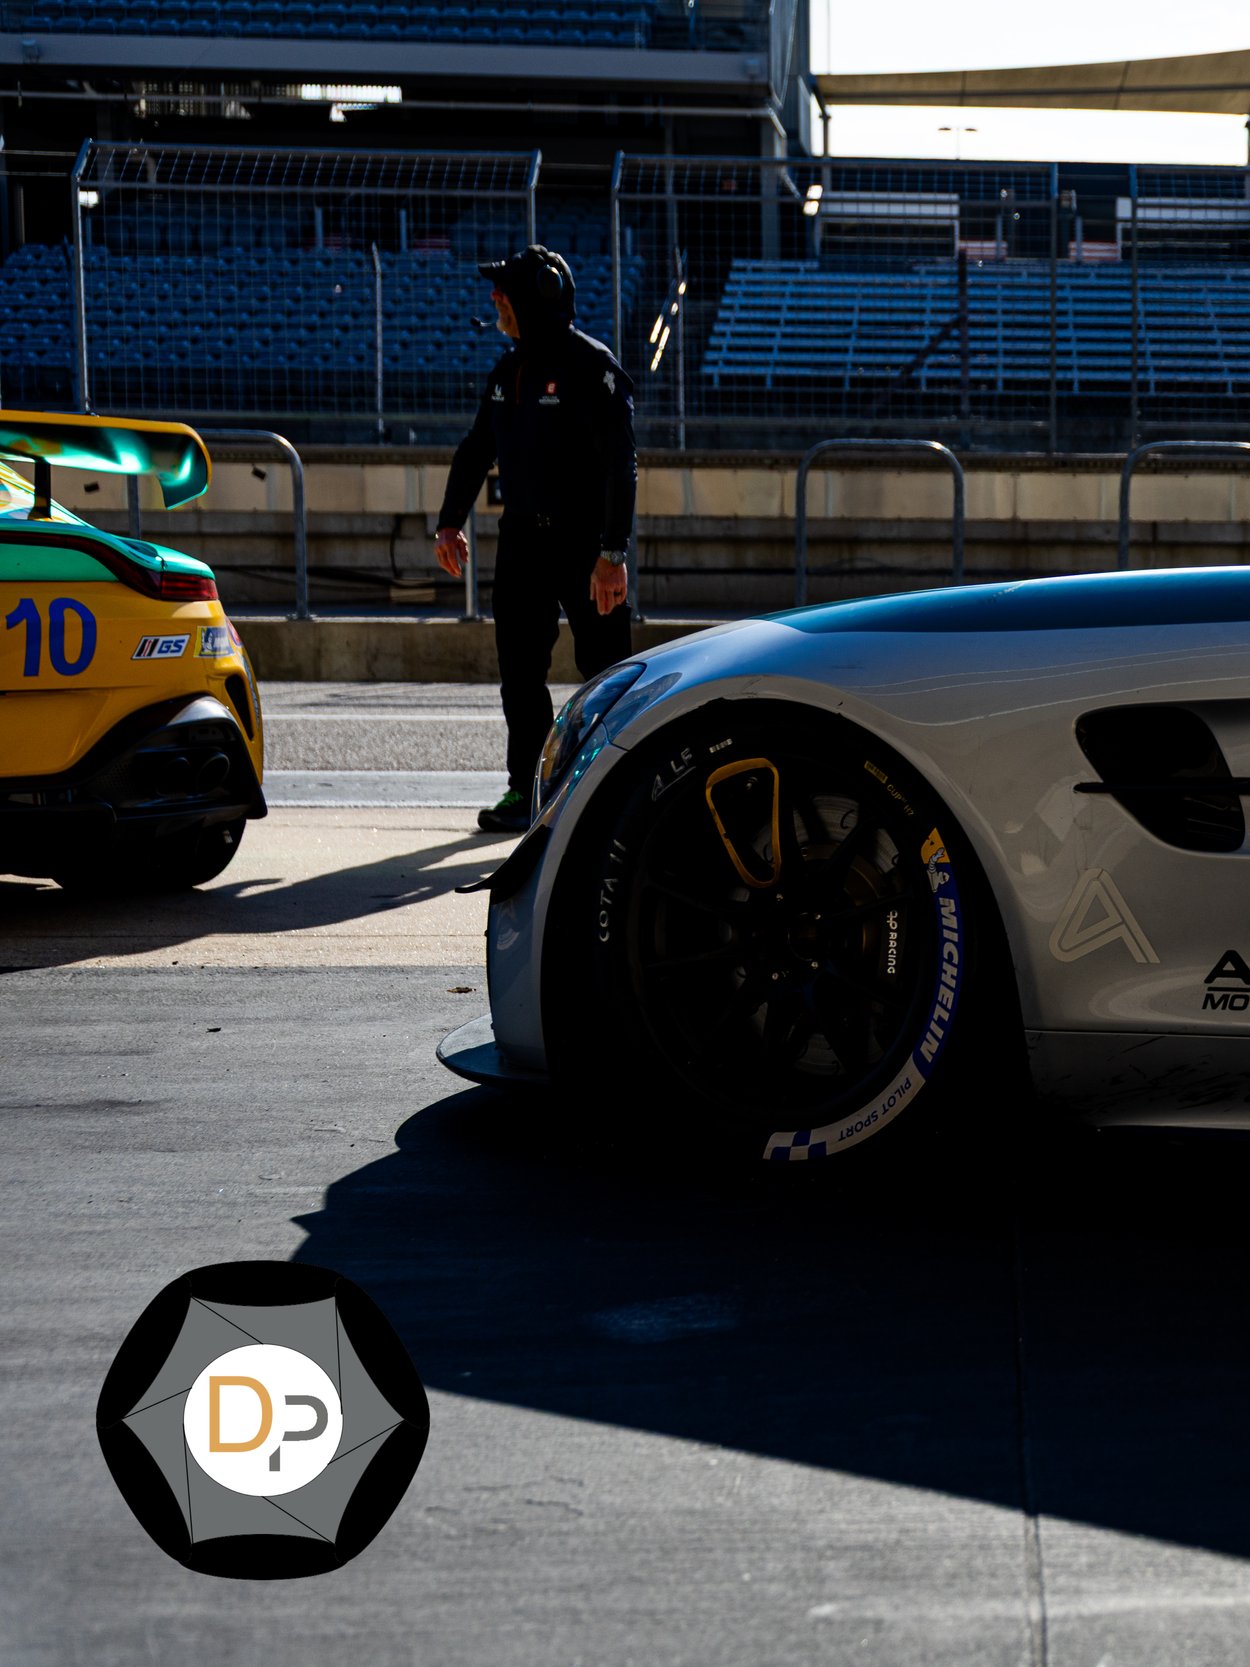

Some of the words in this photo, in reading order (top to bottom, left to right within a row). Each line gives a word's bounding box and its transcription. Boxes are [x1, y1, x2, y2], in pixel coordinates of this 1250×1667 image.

[5, 597, 97, 677] 10
[156, 639, 186, 654] GS
[919, 896, 960, 1064] MICHELIN
[881, 1077, 912, 1115] PILOT
[838, 1110, 879, 1142] SPORT
